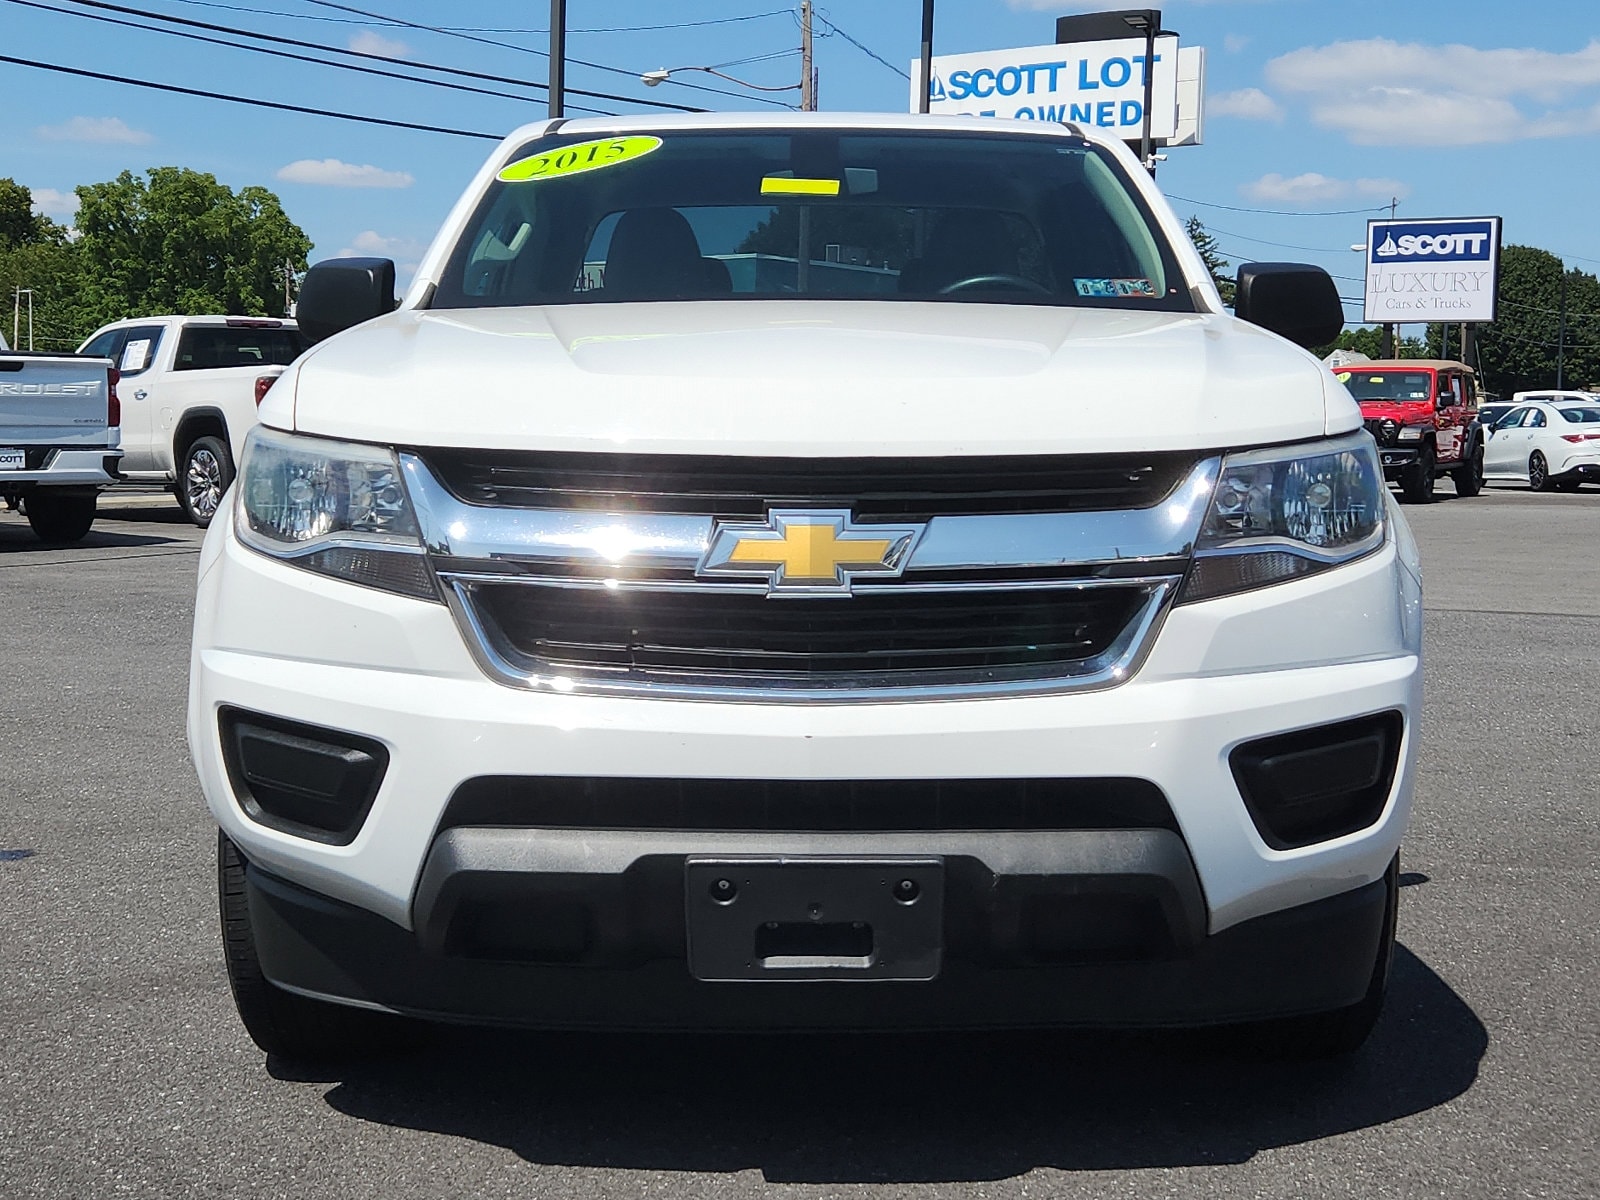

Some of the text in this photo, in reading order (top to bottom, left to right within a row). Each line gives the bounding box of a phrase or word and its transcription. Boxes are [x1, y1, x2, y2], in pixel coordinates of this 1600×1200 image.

[948, 54, 1161, 101] SCOTT LOT
[1015, 100, 1143, 127] OWNED
[528, 139, 628, 176] 2015
[1398, 233, 1487, 256] SCOTT
[1370, 271, 1489, 294] LUXURY
[1385, 297, 1472, 309] Cars & Trucks
[0, 455, 24, 463] COTT
